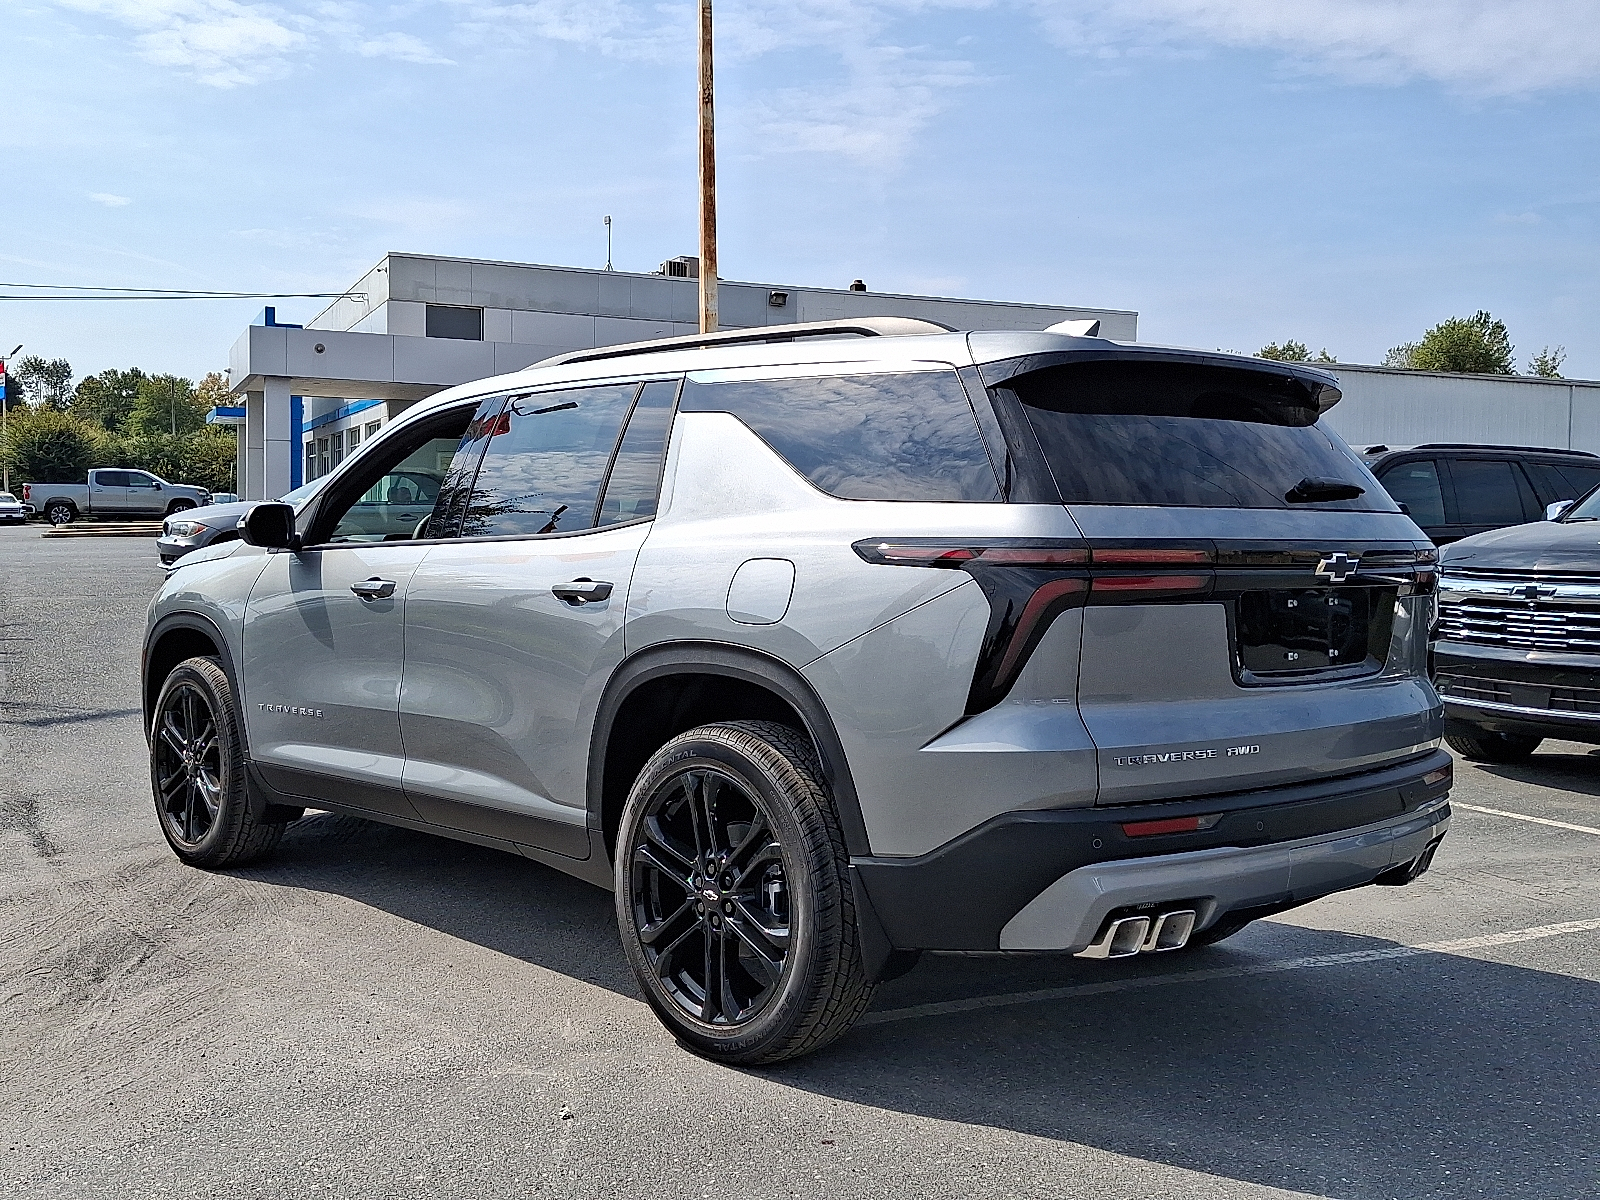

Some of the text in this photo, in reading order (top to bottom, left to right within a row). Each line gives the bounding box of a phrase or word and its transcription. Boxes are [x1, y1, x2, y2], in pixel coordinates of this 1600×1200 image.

[258, 703, 323, 718] TRAVERSE
[1113, 744, 1260, 766] TRAVERSE AWD
